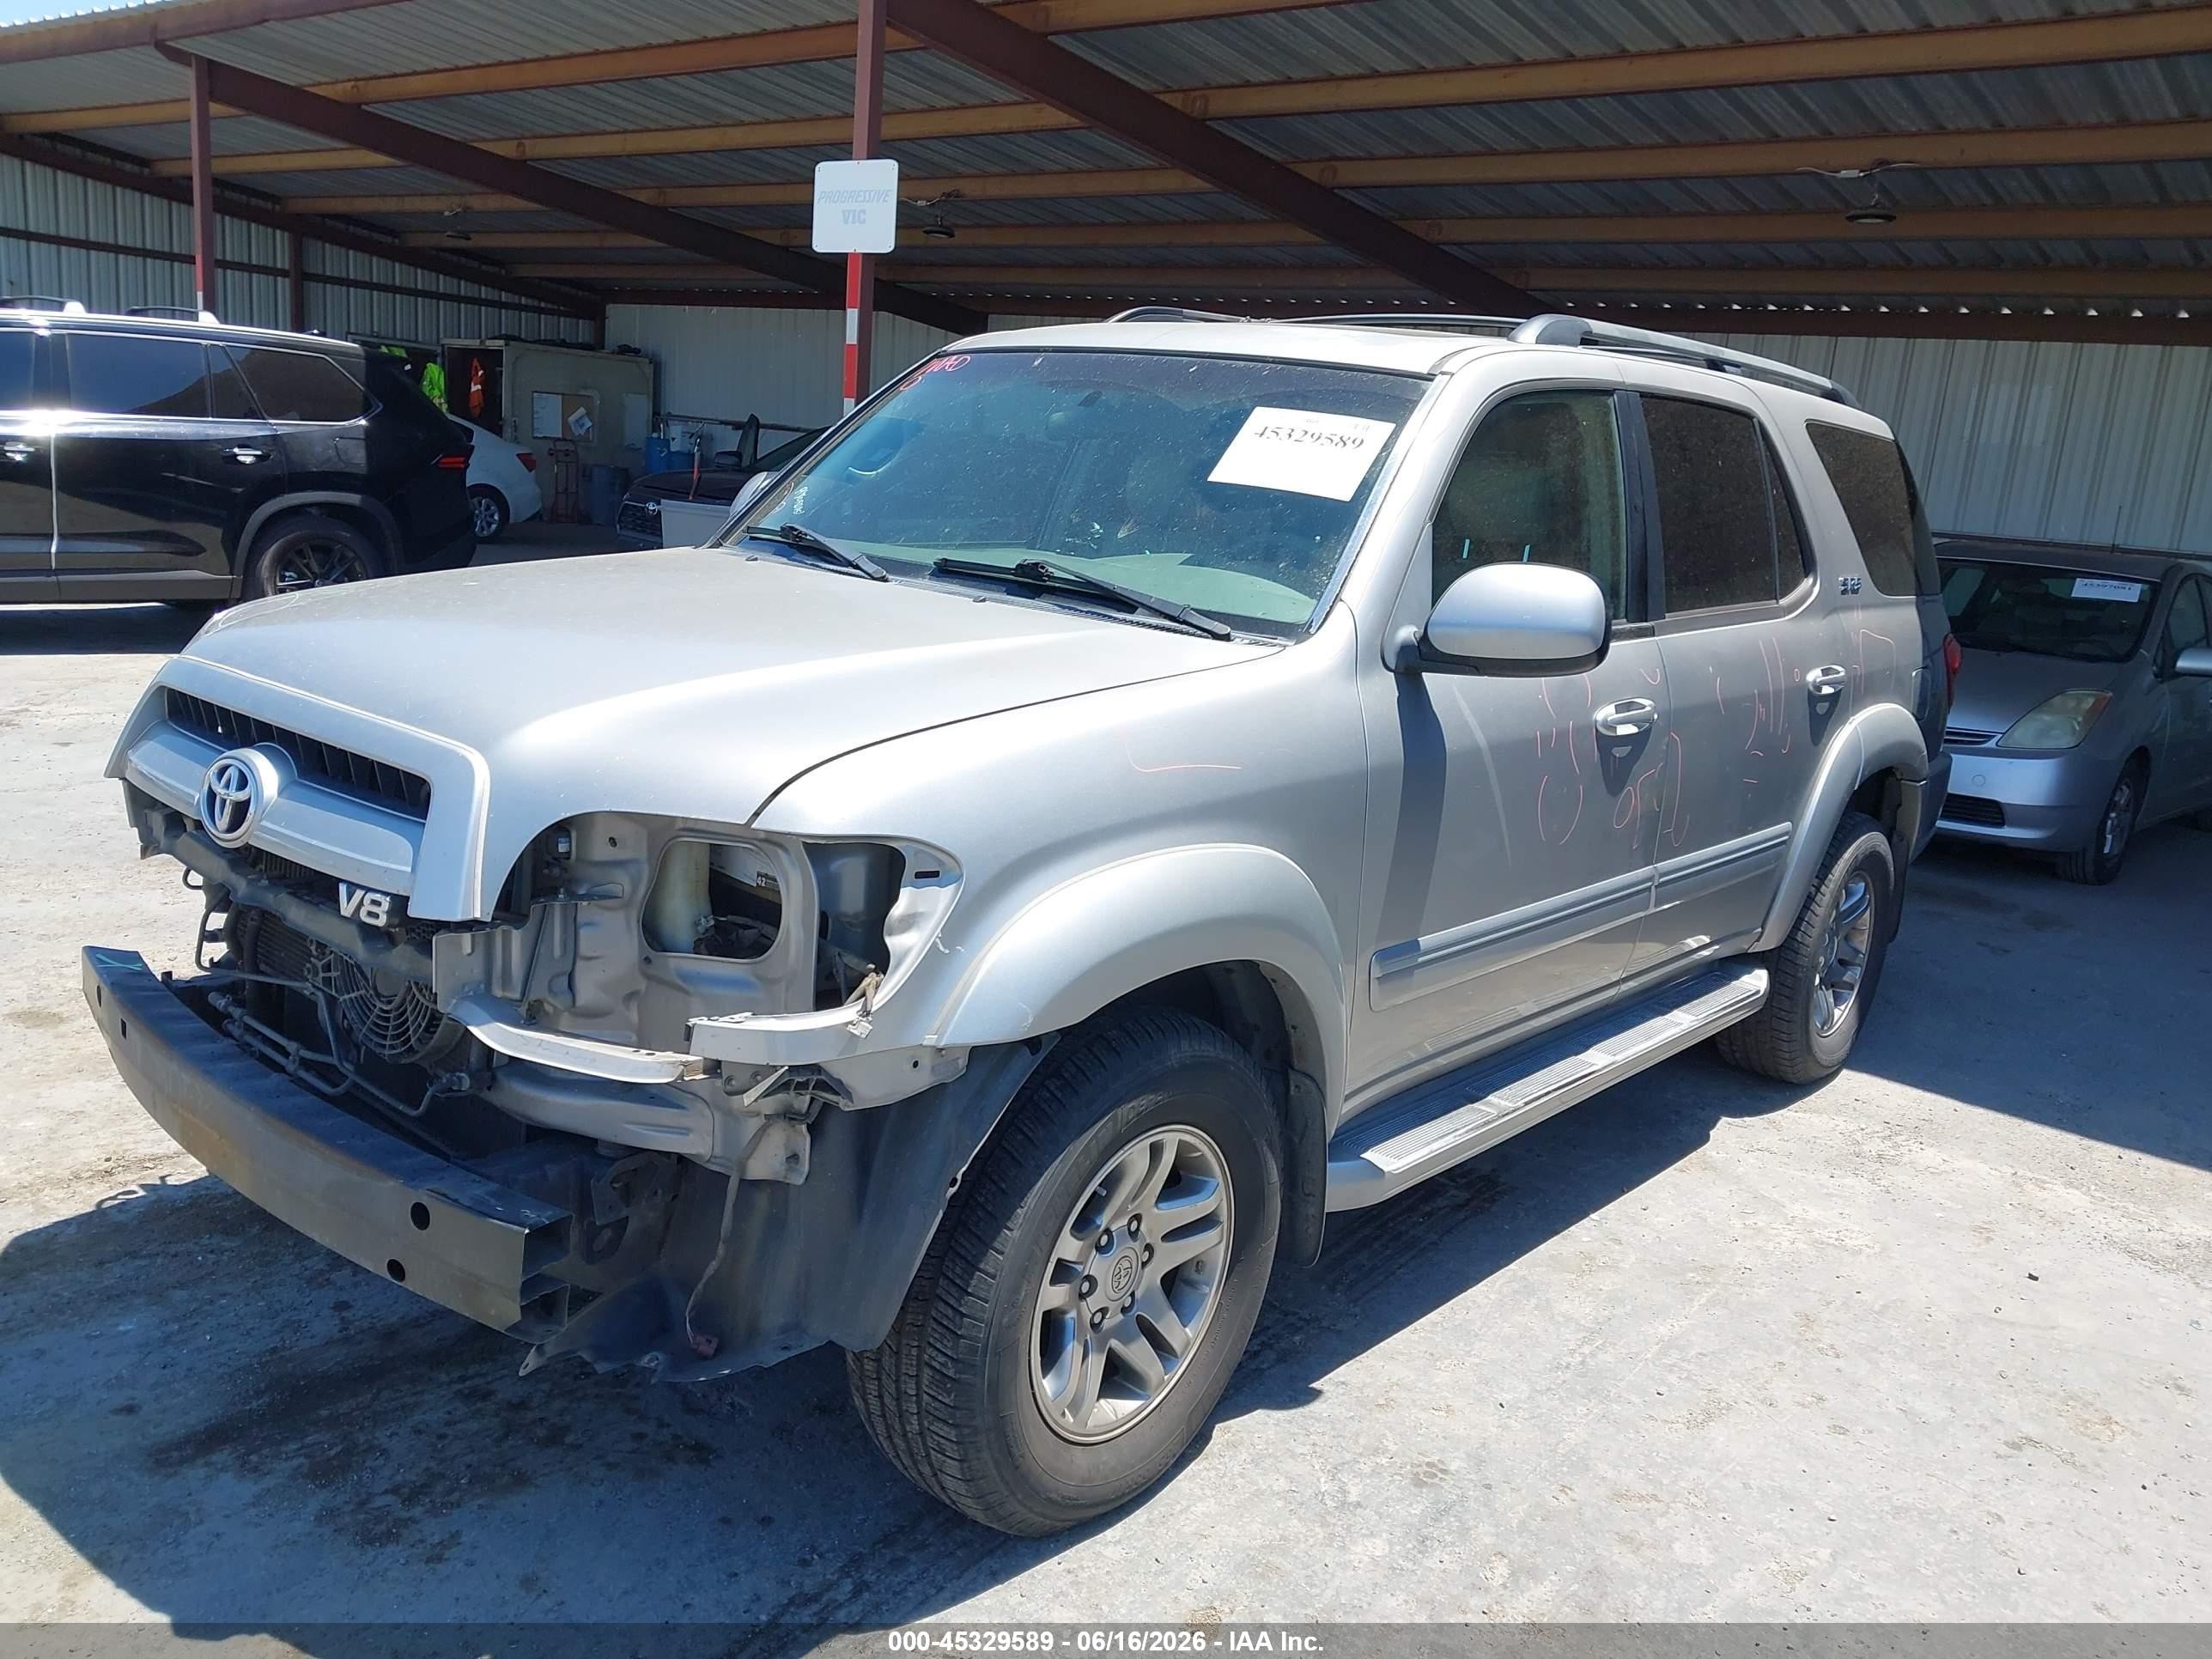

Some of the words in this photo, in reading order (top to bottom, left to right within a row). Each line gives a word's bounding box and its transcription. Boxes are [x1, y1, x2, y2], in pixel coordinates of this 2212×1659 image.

[817, 189, 894, 204] PROGRESSIVE
[841, 209, 866, 225] VIC
[1254, 425, 1365, 449] 45329589
[338, 881, 392, 927] V8
